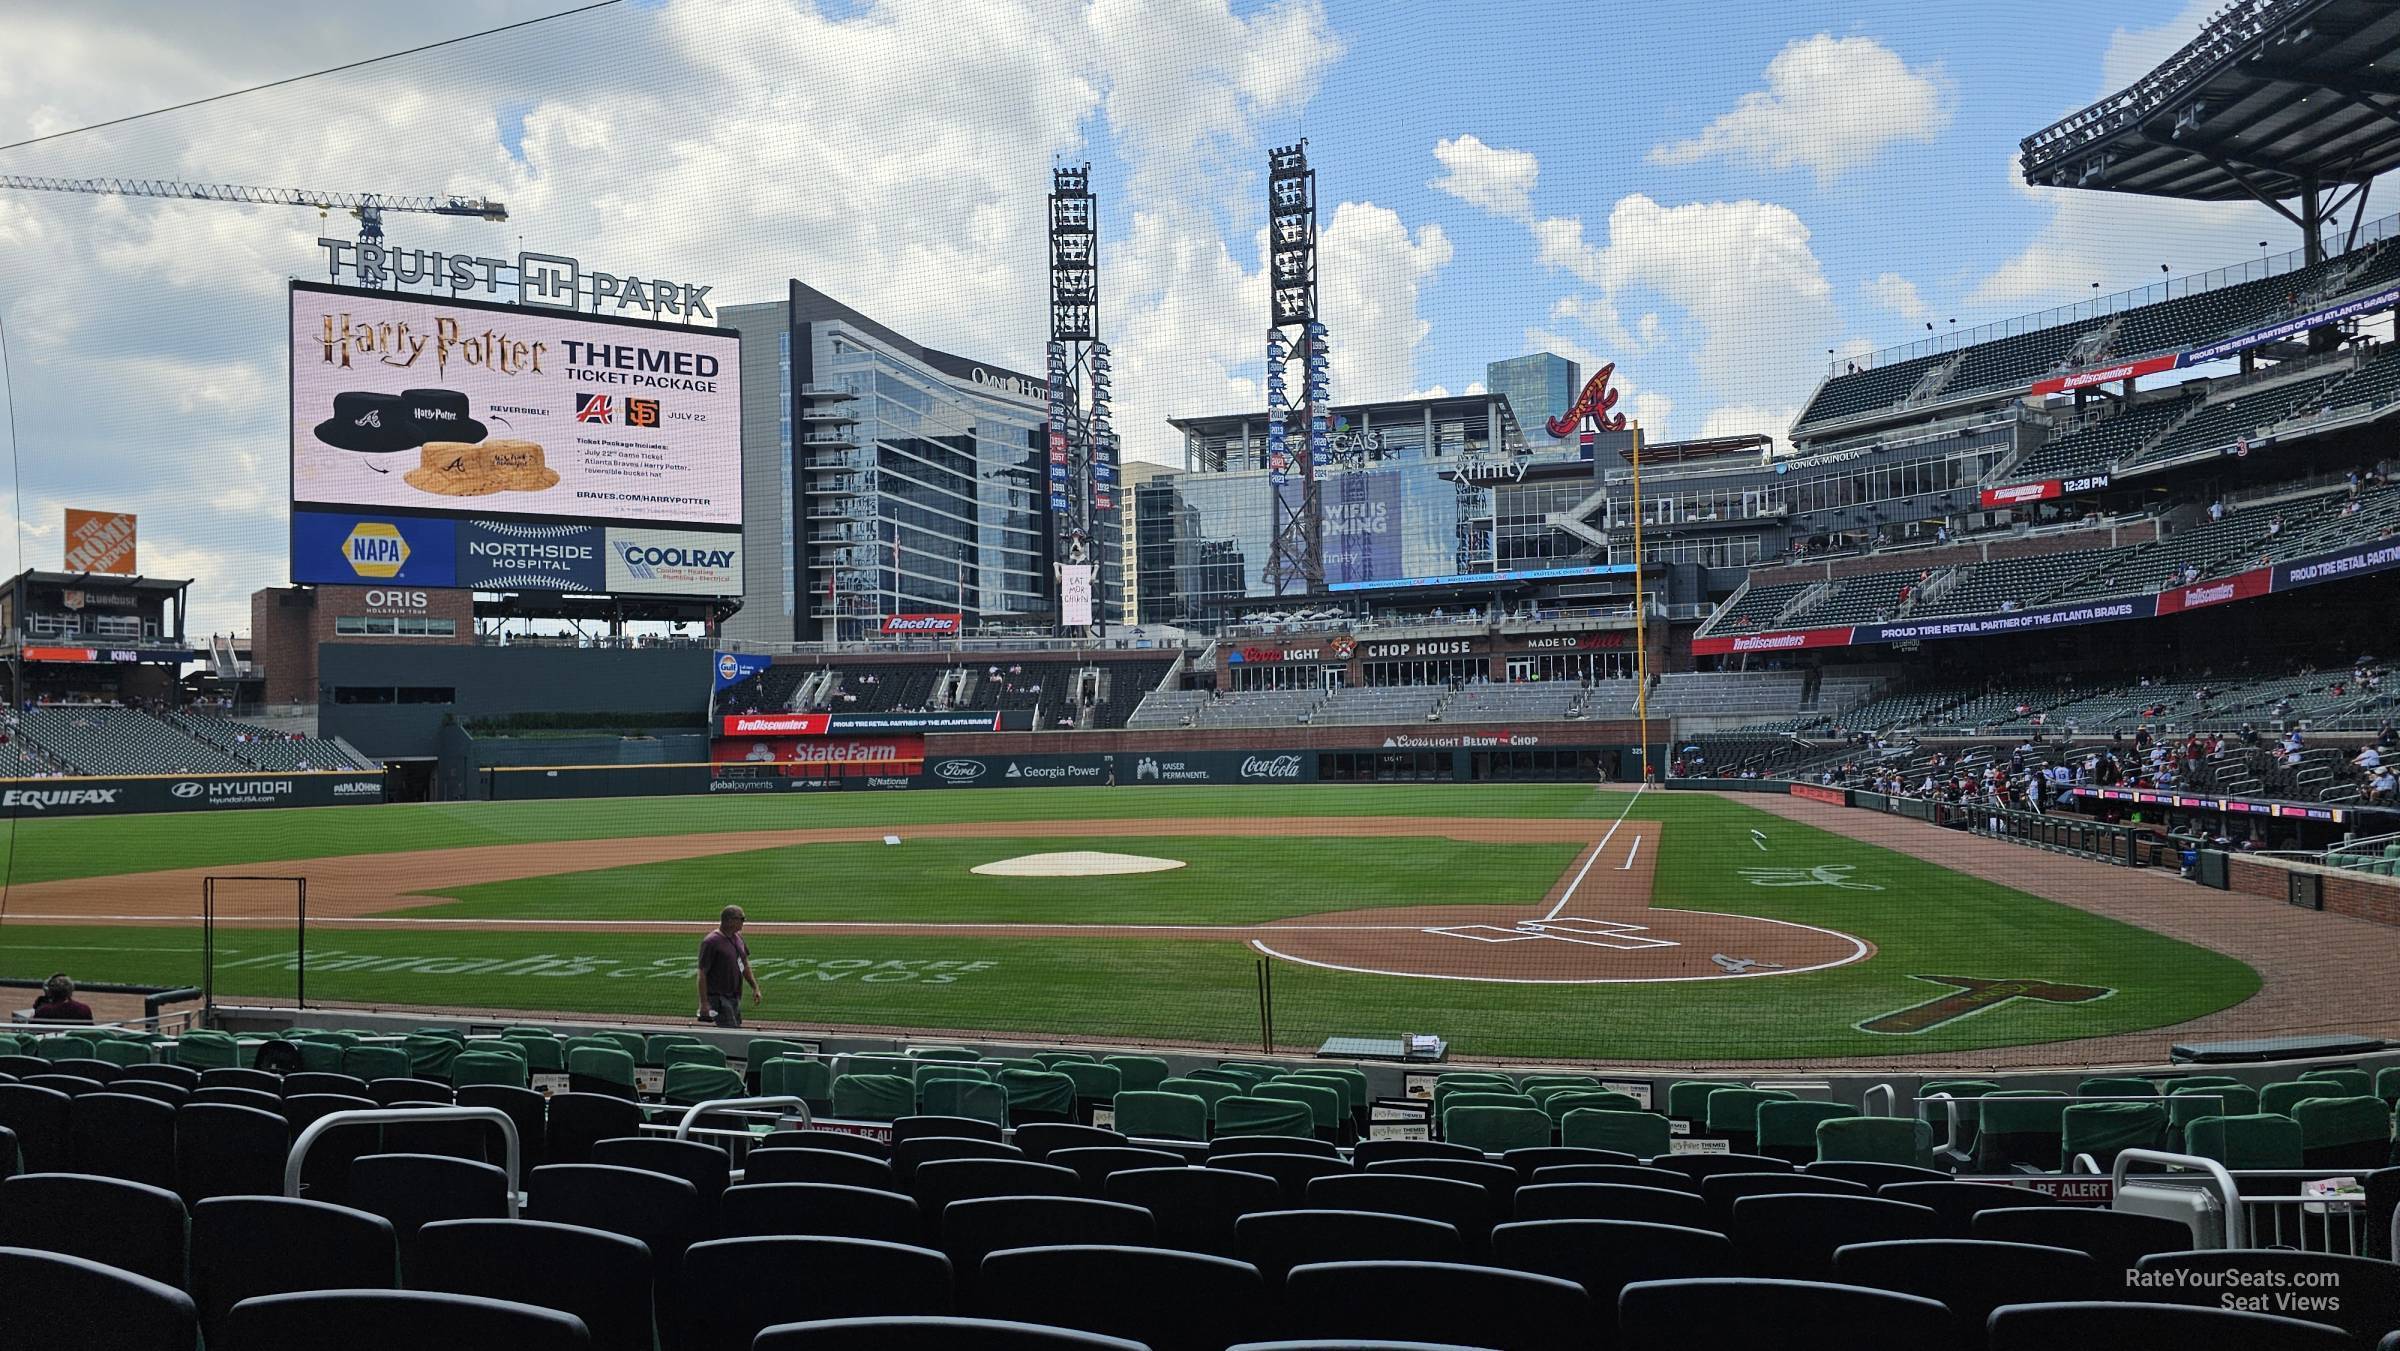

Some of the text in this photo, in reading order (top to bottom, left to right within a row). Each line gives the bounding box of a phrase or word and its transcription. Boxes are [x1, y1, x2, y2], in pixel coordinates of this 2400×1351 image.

[318, 237, 713, 318] TRUIST PARK
[2190, 290, 2400, 362] PROUD TIRE RETAIL PARTNER OF THE ATLANTA BRAVES
[313, 313, 548, 382] Harry Potter
[561, 339, 719, 378] THEMED
[565, 367, 717, 393] TICKET PACKAGE
[971, 367, 1048, 401] OMNI HOT
[414, 407, 457, 421] Harry Potter
[490, 404, 550, 416] REVERSIBLE!
[667, 411, 691, 421] JULY
[693, 414, 706, 422] 22
[576, 438, 669, 450] Ticket Package Includes:
[1334, 433, 1388, 453] CAST
[584, 449, 601, 458] July
[618, 452, 640, 460] Game
[641, 452, 663, 461] Ticket
[1787, 451, 1860, 472] KONICA MINOLTA
[584, 458, 612, 467] Atlanta
[613, 460, 639, 468] Braves
[644, 462, 665, 472] Harry
[584, 467, 662, 478] reversible bucket hat
[2063, 475, 2108, 493] 12:28 PM
[576, 491, 711, 506] BRAVES.COM/HARRYPOTTER
[1370, 501, 1387, 517] IS
[72, 516, 103, 542] THE
[65, 513, 136, 571] HOME
[353, 537, 400, 562] NAPA
[93, 537, 136, 573] DEPOT
[469, 541, 593, 560] NORTHSIDE
[624, 546, 736, 569] COOLRAY
[1324, 551, 1360, 565] finity
[492, 557, 571, 572] HOSPITAL
[656, 567, 682, 575] Cooling
[2290, 546, 2400, 582] PROUD TIRE RETAIL PARTN
[662, 573, 730, 583] Plumbing Electrical
[365, 590, 428, 608] ORIS
[888, 618, 953, 630] RaceTrac
[1881, 603, 2133, 638] PROUD TIRE RETAIL PARTNER OF THE ATLANTA BRAVES
[1368, 641, 1470, 657] CHOP HOUSE
[1528, 638, 1559, 648] MADE
[1562, 637, 1576, 646] TO
[110, 650, 137, 662] KING
[1243, 647, 1320, 663] Coors LIGHT
[721, 663, 737, 671] Gulf
[940, 718, 968, 726] ATLANTA
[1396, 734, 1429, 748] Coors
[1429, 737, 1459, 748] LIGHT
[944, 762, 978, 777] Ford
[1023, 764, 1101, 779] Georgia Power
[1162, 762, 1185, 771] KAISER
[1241, 755, 1302, 777] Coca-Cola
[876, 777, 909, 786] National
[1162, 771, 1207, 780] PERMANENTE
[208, 780, 293, 796] HYUNDAI
[710, 780, 774, 792] globalpayments
[2, 788, 118, 810] EQUIFAX
[606, 967, 968, 984] CAINOS
[860, 1129, 874, 1139] BE
[2037, 1183, 2108, 1197] BE ALERT
